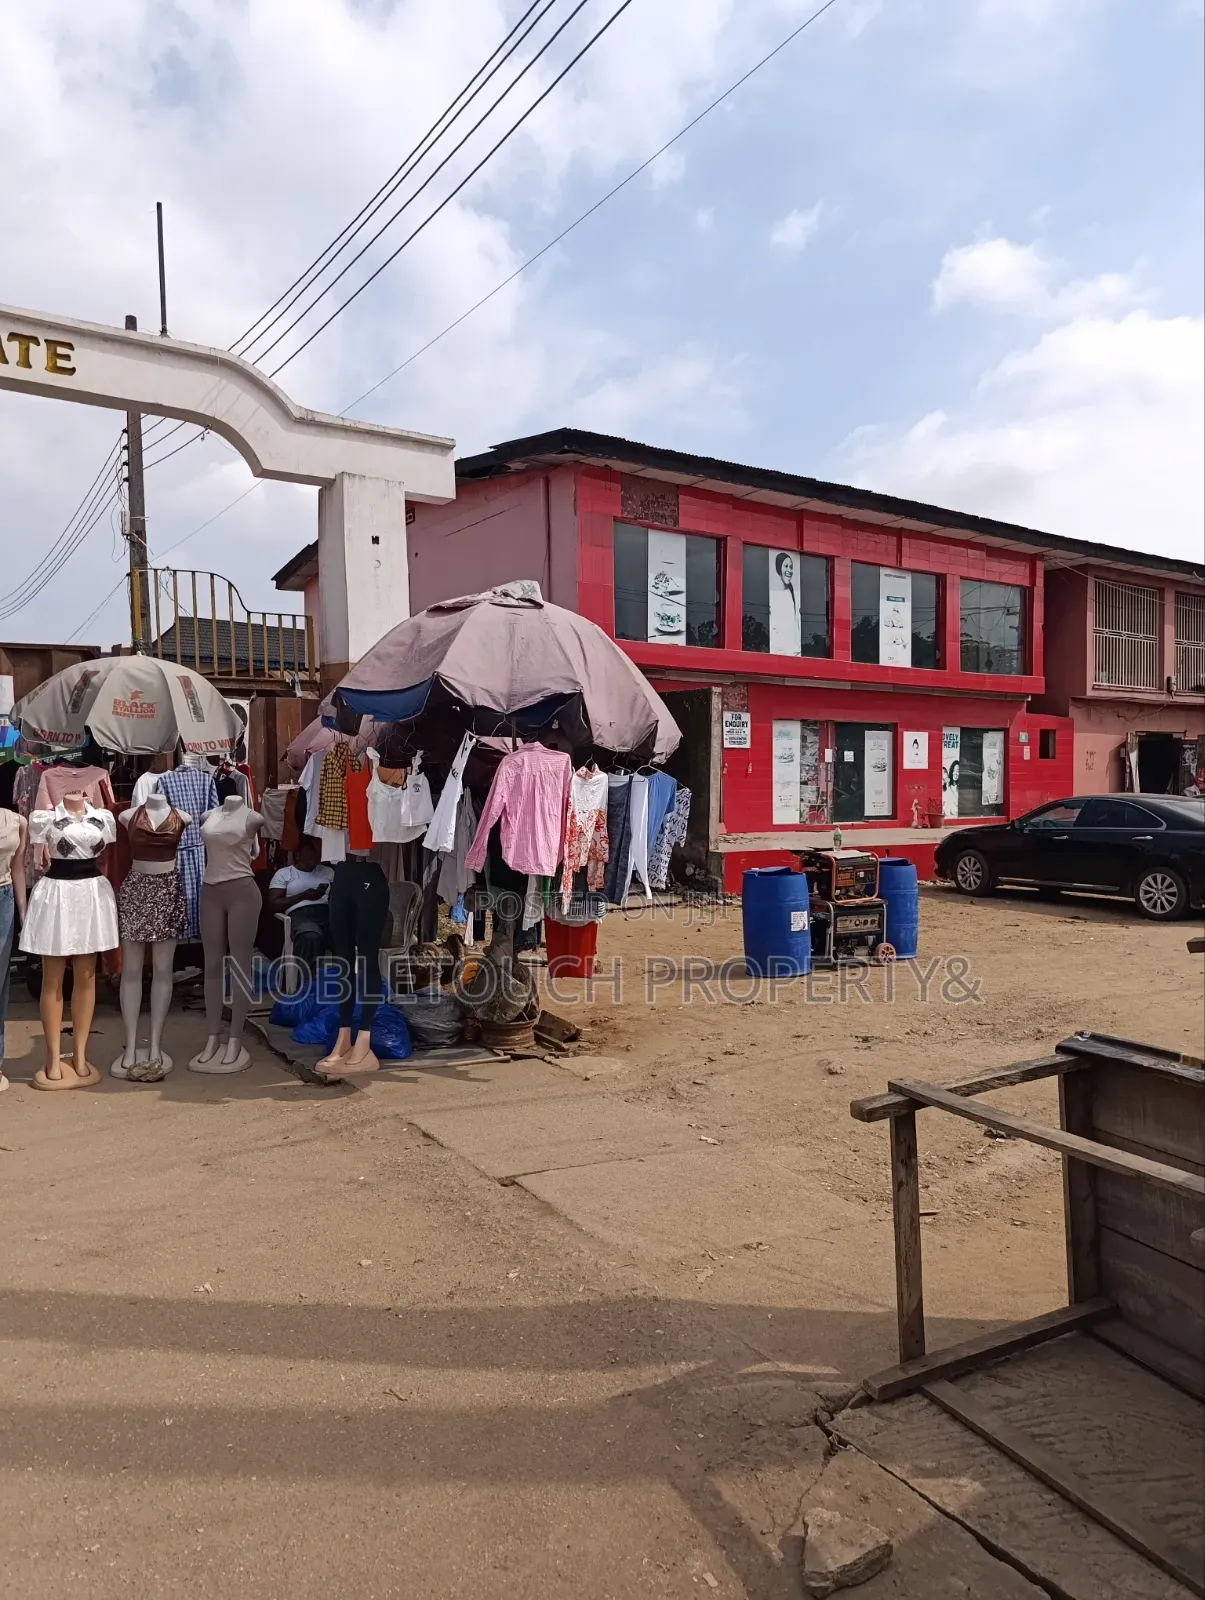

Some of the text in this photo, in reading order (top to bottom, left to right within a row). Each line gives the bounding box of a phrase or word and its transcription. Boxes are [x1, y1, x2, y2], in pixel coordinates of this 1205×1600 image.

[113, 698, 156, 709] BLACK
[113, 705, 156, 714] STALLION
[731, 713, 742, 721] FOR
[725, 720, 749, 728] ENQUIRY
[62, 732, 74, 743] TO
[203, 740, 217, 751] TO
